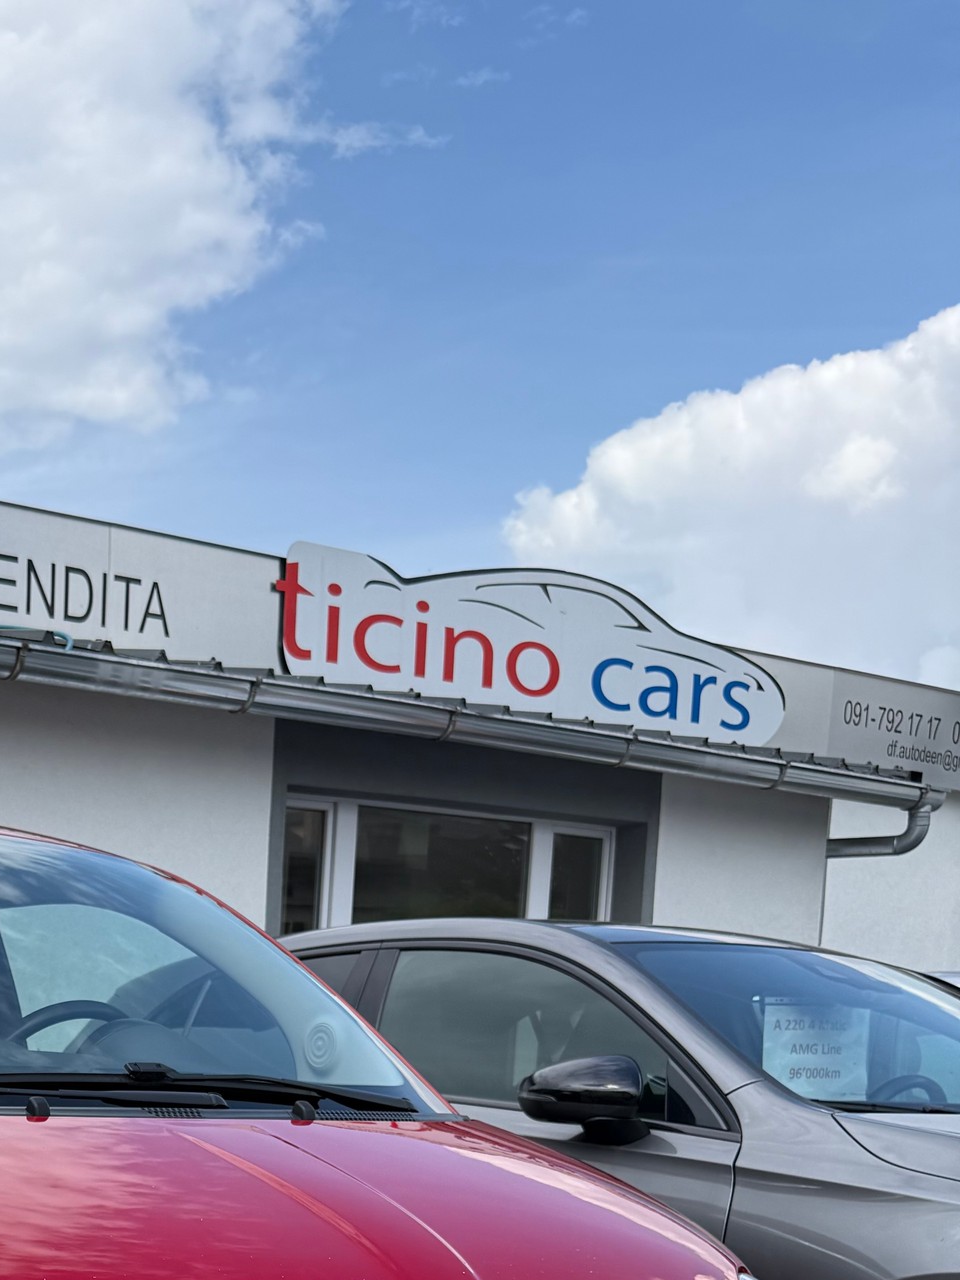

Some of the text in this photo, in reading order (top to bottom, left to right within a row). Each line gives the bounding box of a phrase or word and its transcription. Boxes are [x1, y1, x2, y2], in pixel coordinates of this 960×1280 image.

[275, 561, 751, 731] ticino cars
[843, 699, 904, 735] 091-792
[908, 711, 923, 738] 17
[927, 715, 942, 741] 17
[886, 739, 960, 772] df.autodeen@g
[773, 1019, 782, 1031] A
[785, 1019, 806, 1031] 220
[789, 1043, 843, 1056] AMG Line
